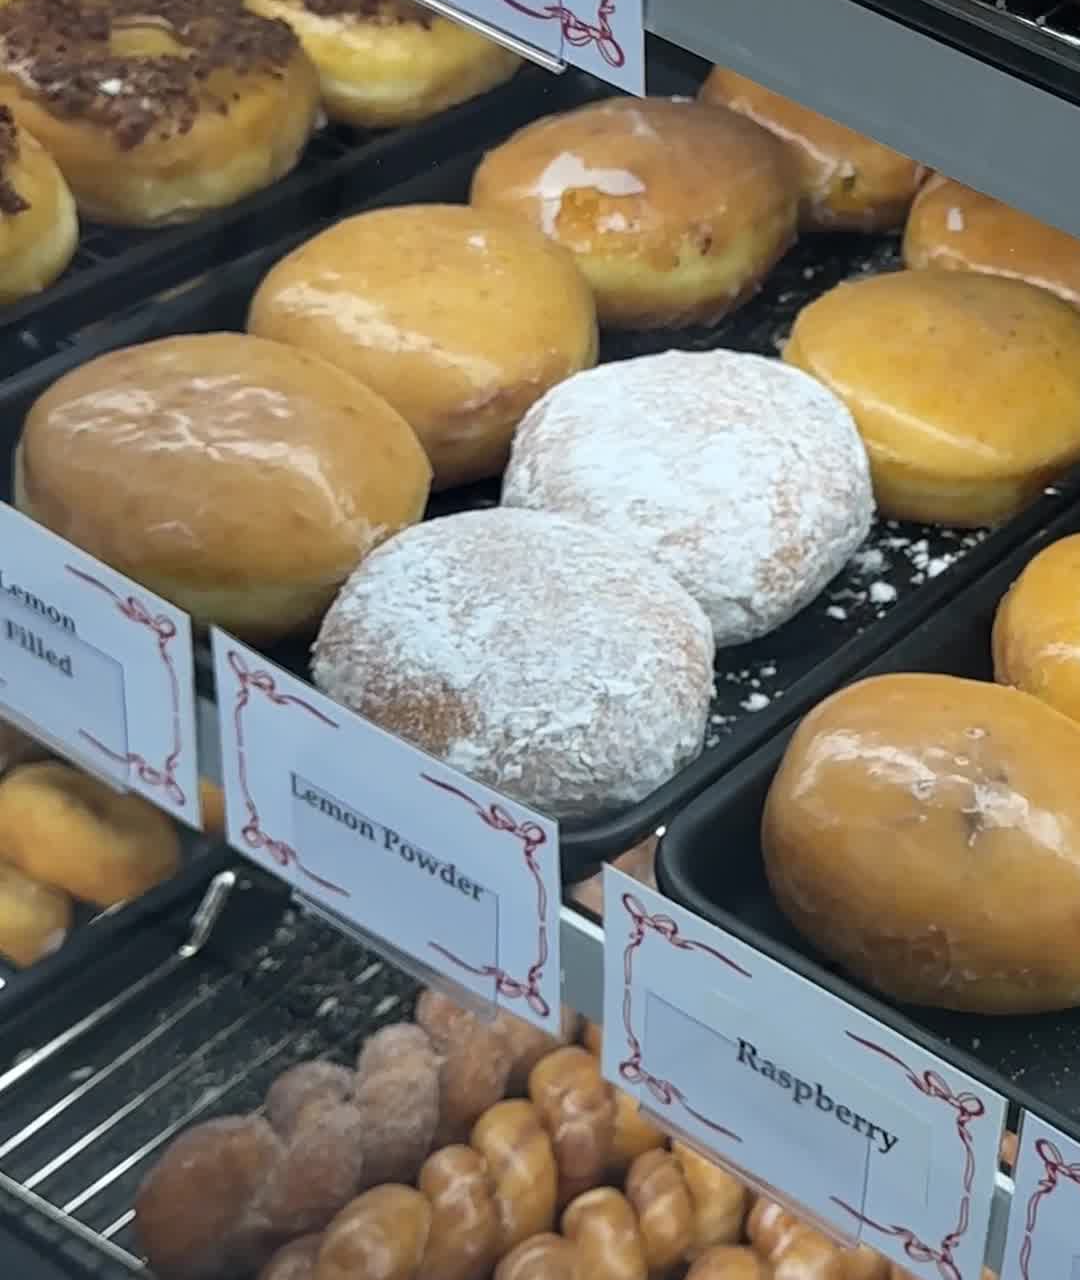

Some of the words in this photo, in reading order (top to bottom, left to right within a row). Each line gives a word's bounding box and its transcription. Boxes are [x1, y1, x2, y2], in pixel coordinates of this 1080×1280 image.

[5, 619, 74, 679] Filled
[289, 771, 375, 842] Lemon
[382, 830, 485, 903] Powder
[735, 1036, 899, 1154] Raspberry
